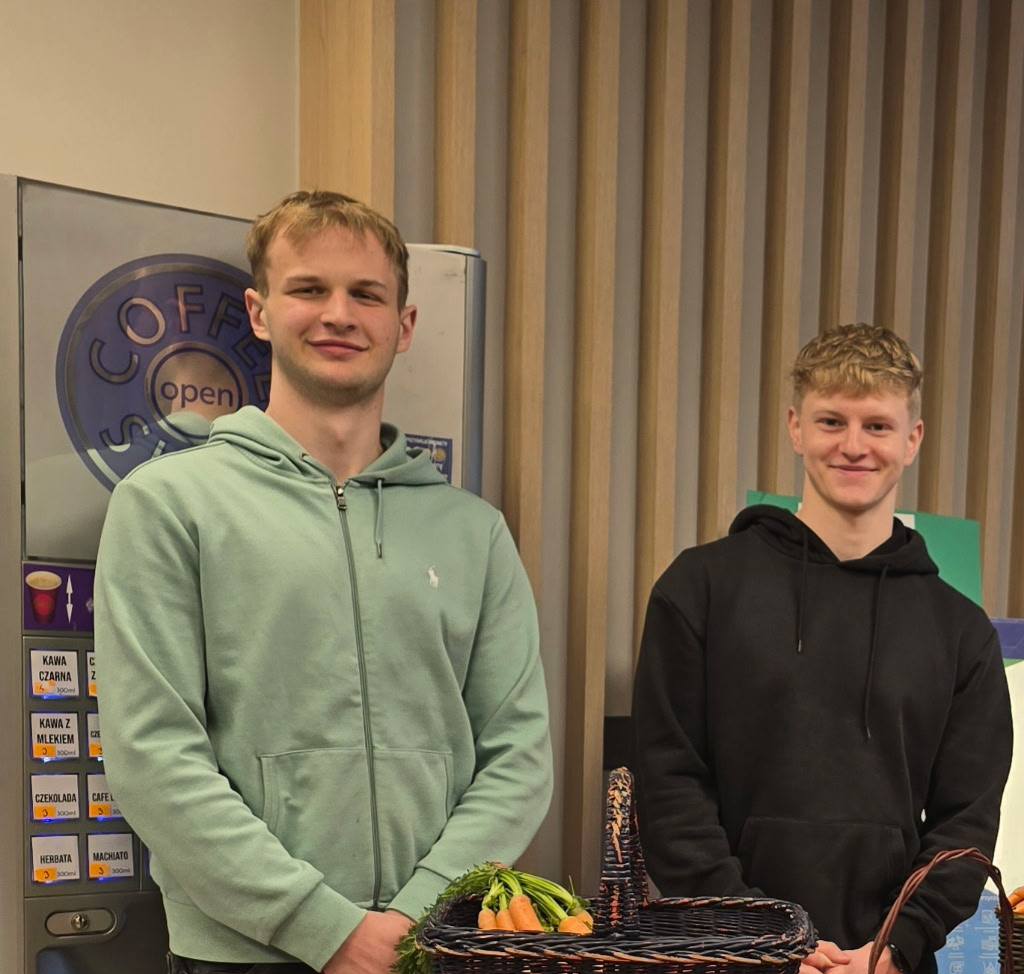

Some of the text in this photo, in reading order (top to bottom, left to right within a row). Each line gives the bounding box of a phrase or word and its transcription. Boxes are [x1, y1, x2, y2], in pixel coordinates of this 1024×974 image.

[160, 381, 233, 408] open
[42, 655, 67, 666] KAWA
[39, 671, 72, 682] CZARNA
[39, 718, 71, 729] KAWA Z
[37, 734, 75, 744] MLEKIEM
[35, 793, 77, 803] CZEKOLADA
[92, 792, 109, 802] CAFE
[40, 854, 72, 864] HERBATA
[93, 851, 129, 861] MACHIATO
